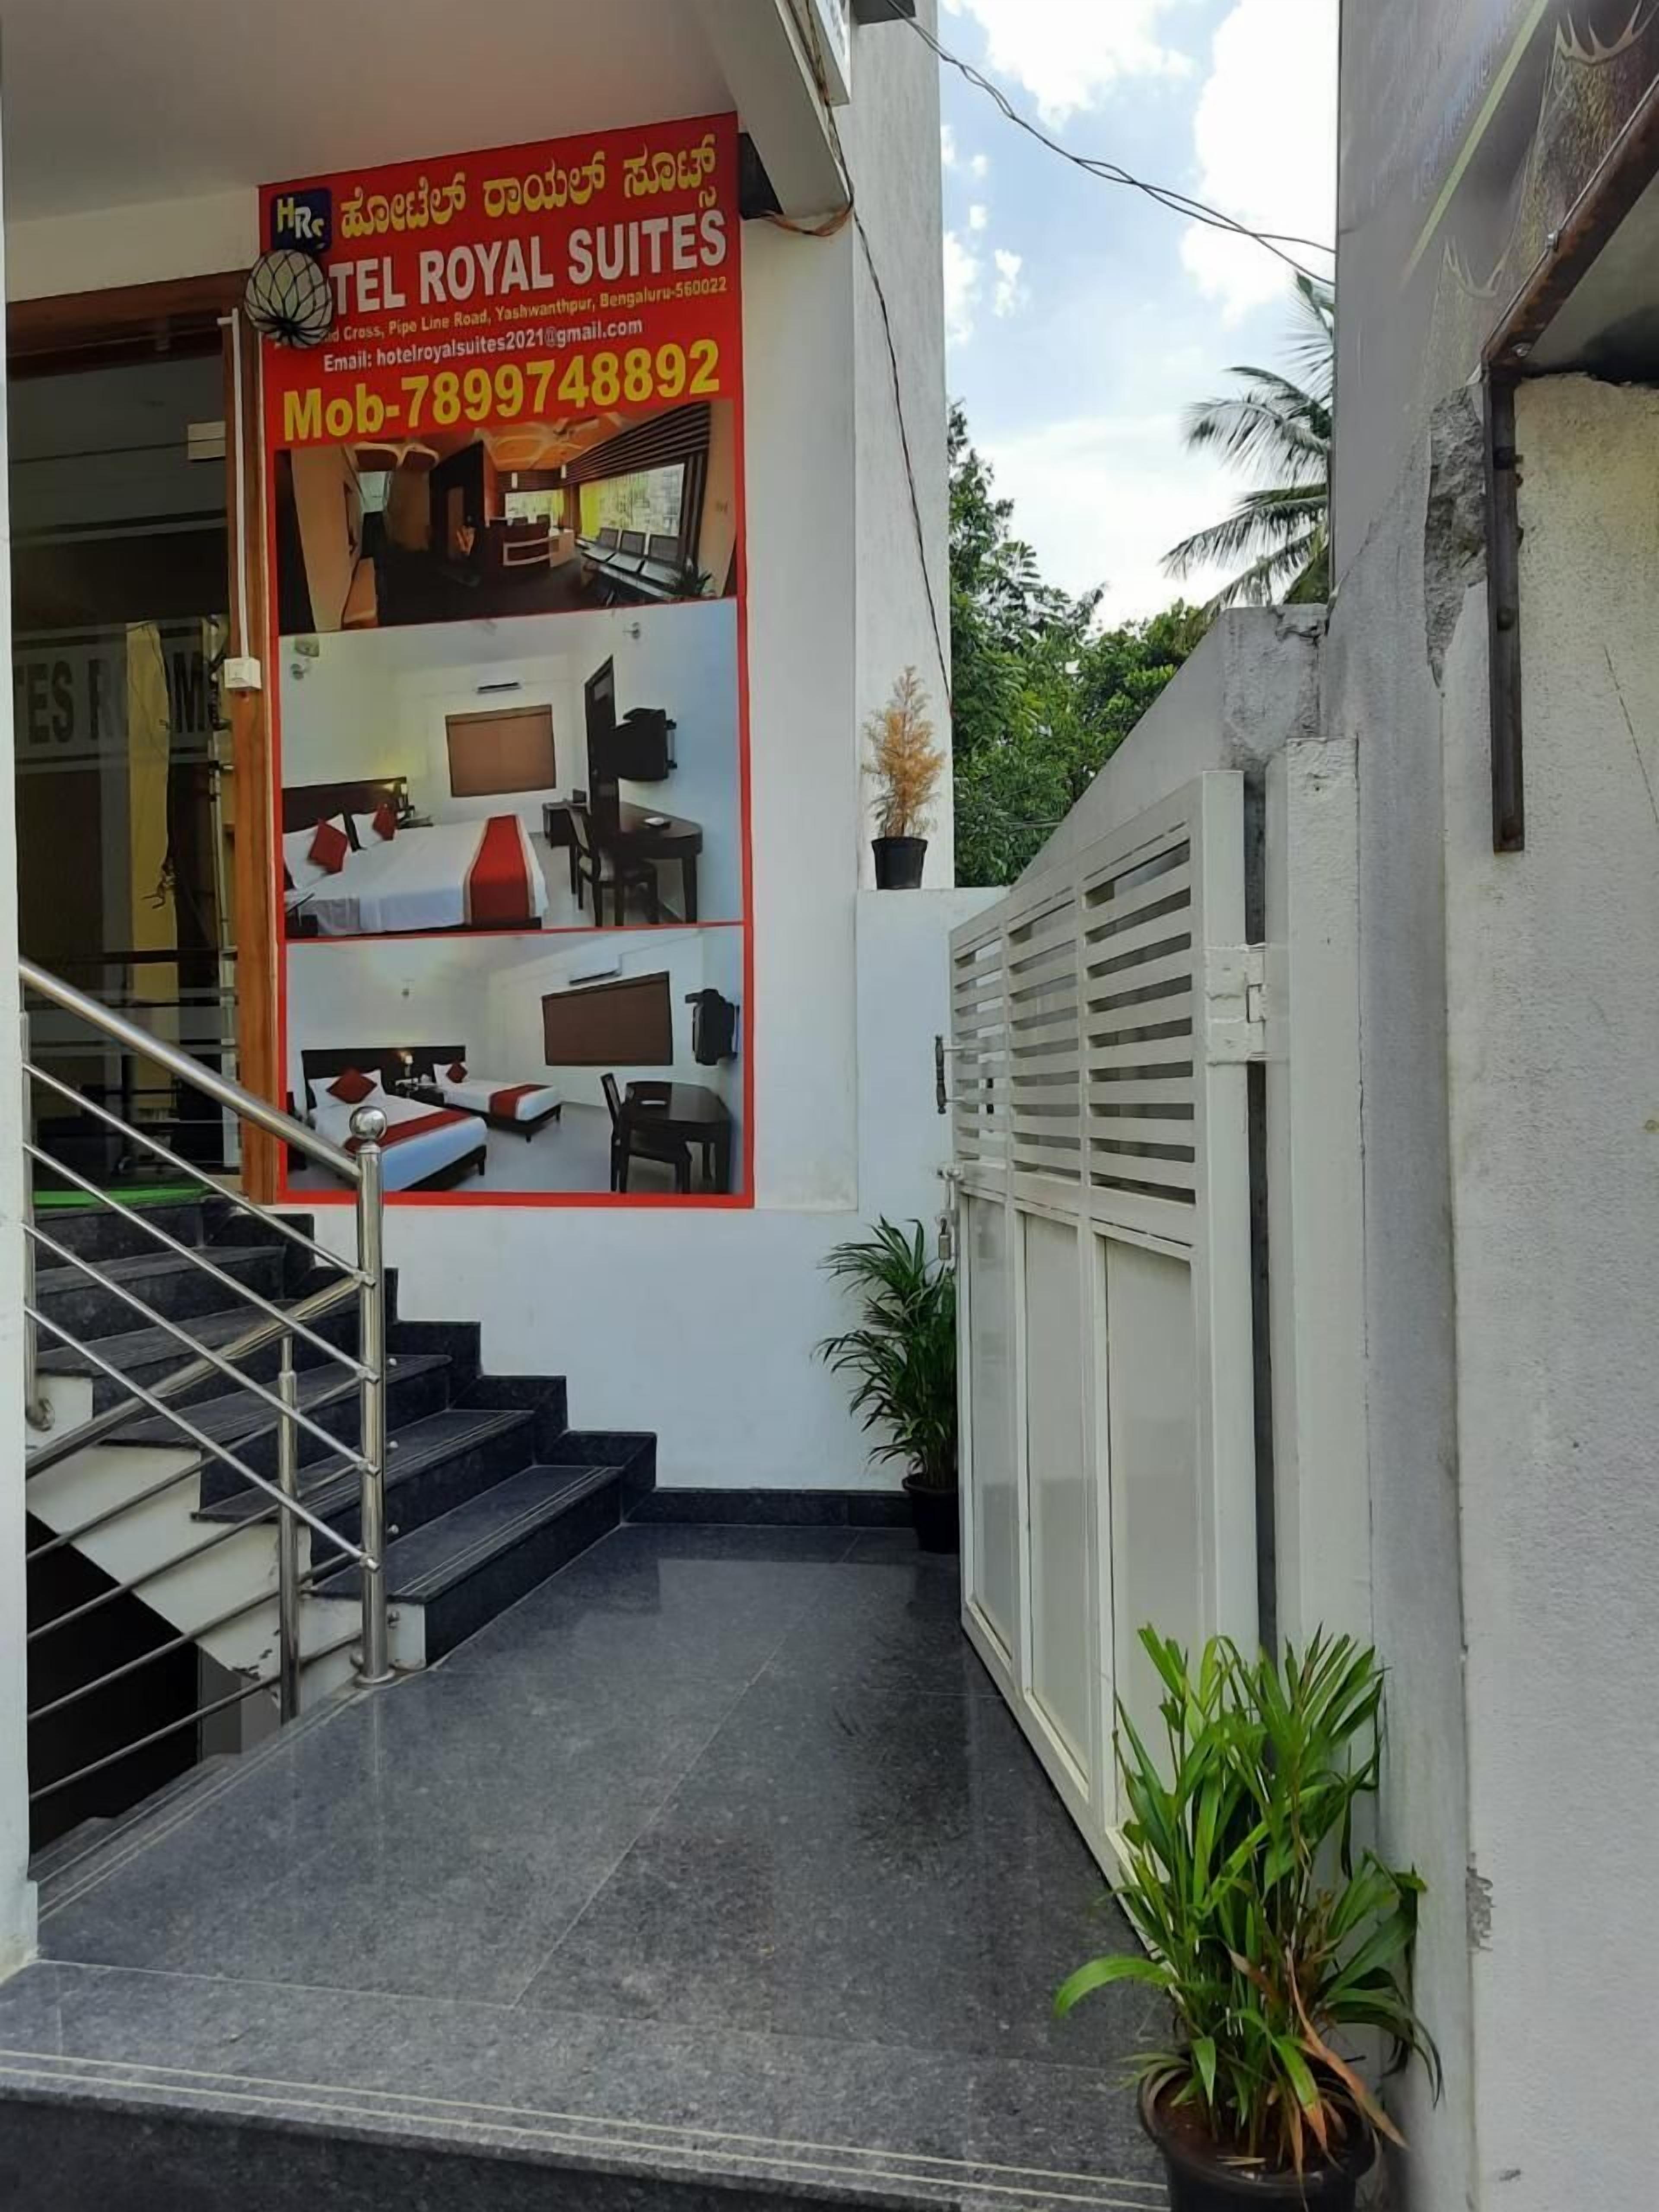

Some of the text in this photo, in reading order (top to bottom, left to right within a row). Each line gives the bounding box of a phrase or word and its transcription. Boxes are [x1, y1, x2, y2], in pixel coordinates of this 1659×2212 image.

[340, 171, 466, 238] ಹೋಟೆಲ್
[483, 151, 605, 217] ರಾಯಲ್
[328, 209, 726, 315] TEL ROYAL SUITES
[324, 319, 643, 373] Email: hotelroyalsuites2021@gmail.com
[344, 326, 385, 341] Cross,
[389, 319, 417, 338] Pipe
[421, 316, 450, 331] Line
[454, 308, 491, 327] Road,
[495, 298, 595, 321] Yashwanthpur,
[599, 276, 727, 308] Bengaluru-560022
[283, 339, 720, 442] Mob-7899748892
